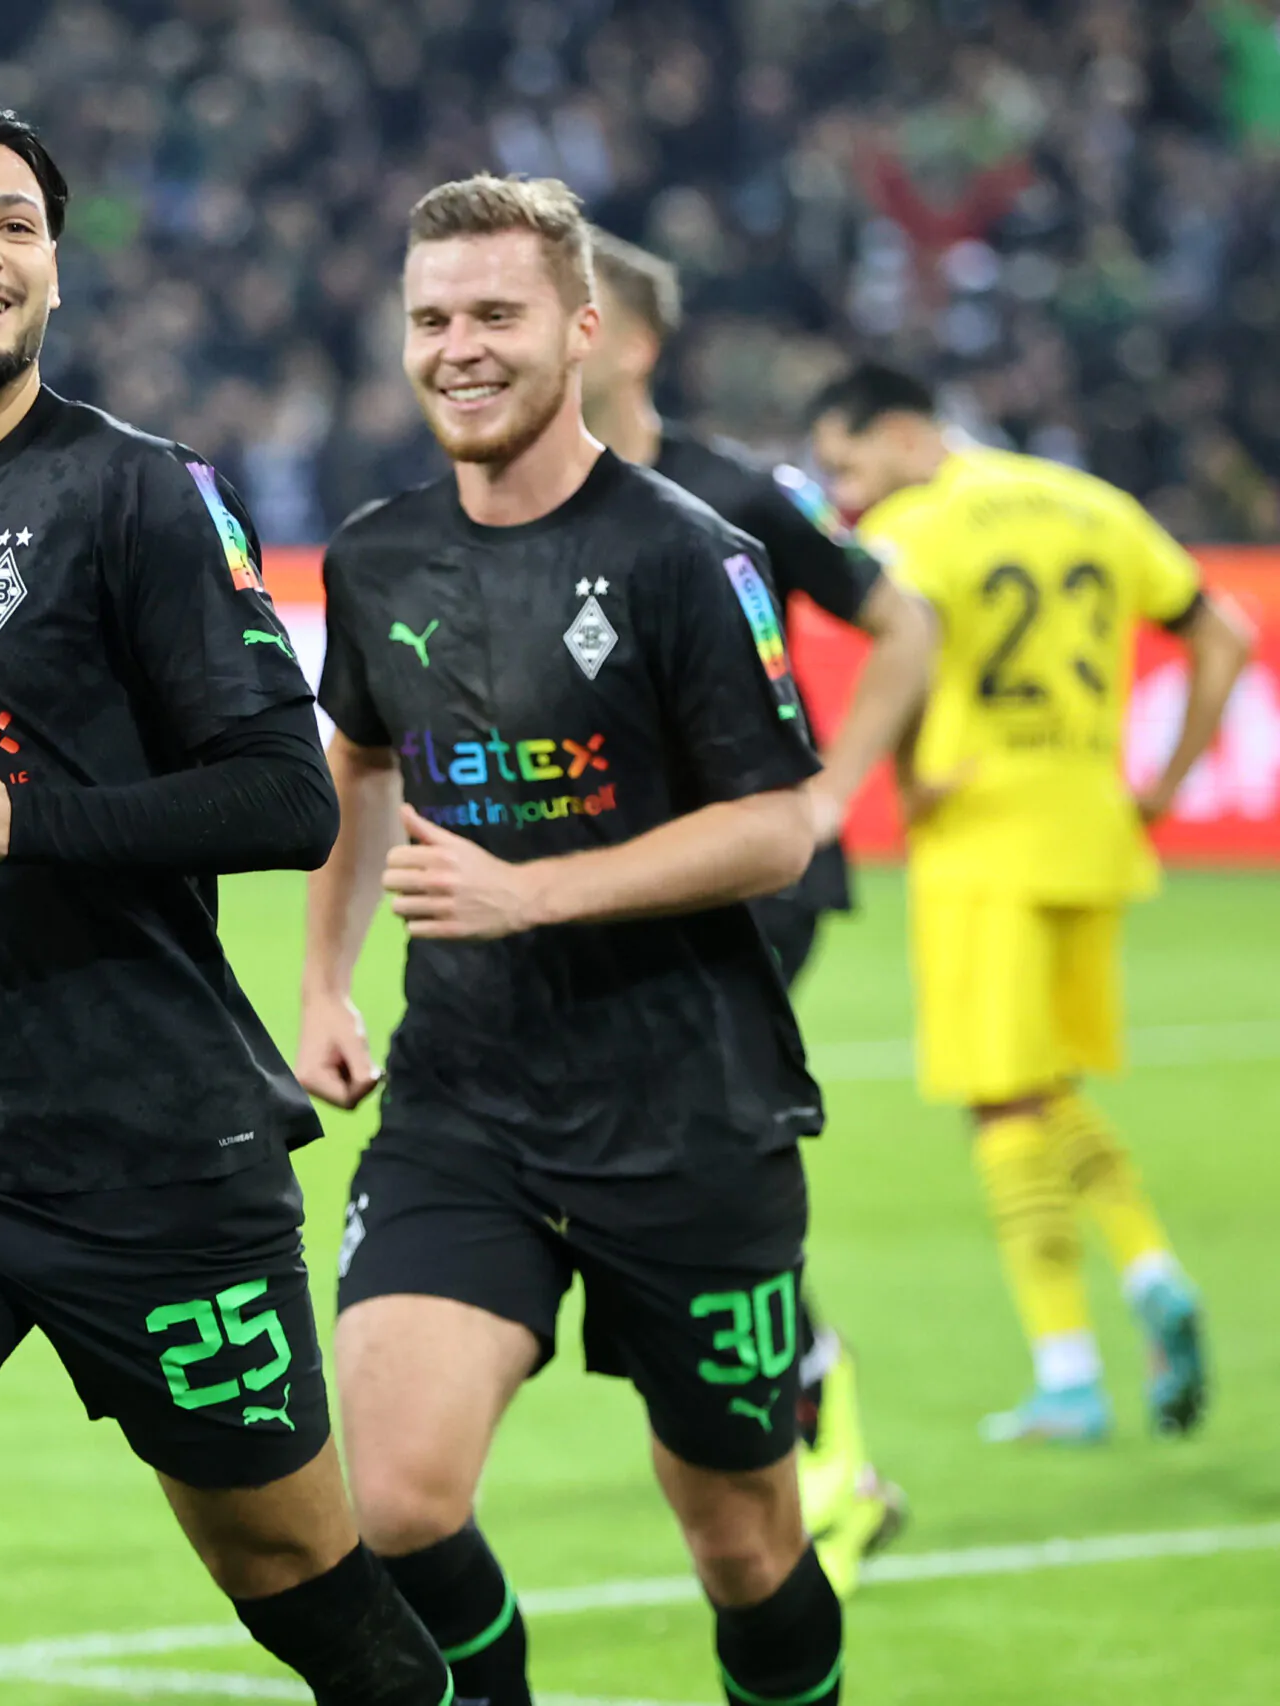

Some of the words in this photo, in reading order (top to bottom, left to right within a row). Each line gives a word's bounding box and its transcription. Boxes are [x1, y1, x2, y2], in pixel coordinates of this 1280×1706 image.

[976, 562, 1114, 706] 23
[145, 1277, 292, 1409] 25
[689, 1271, 796, 1384] 30
